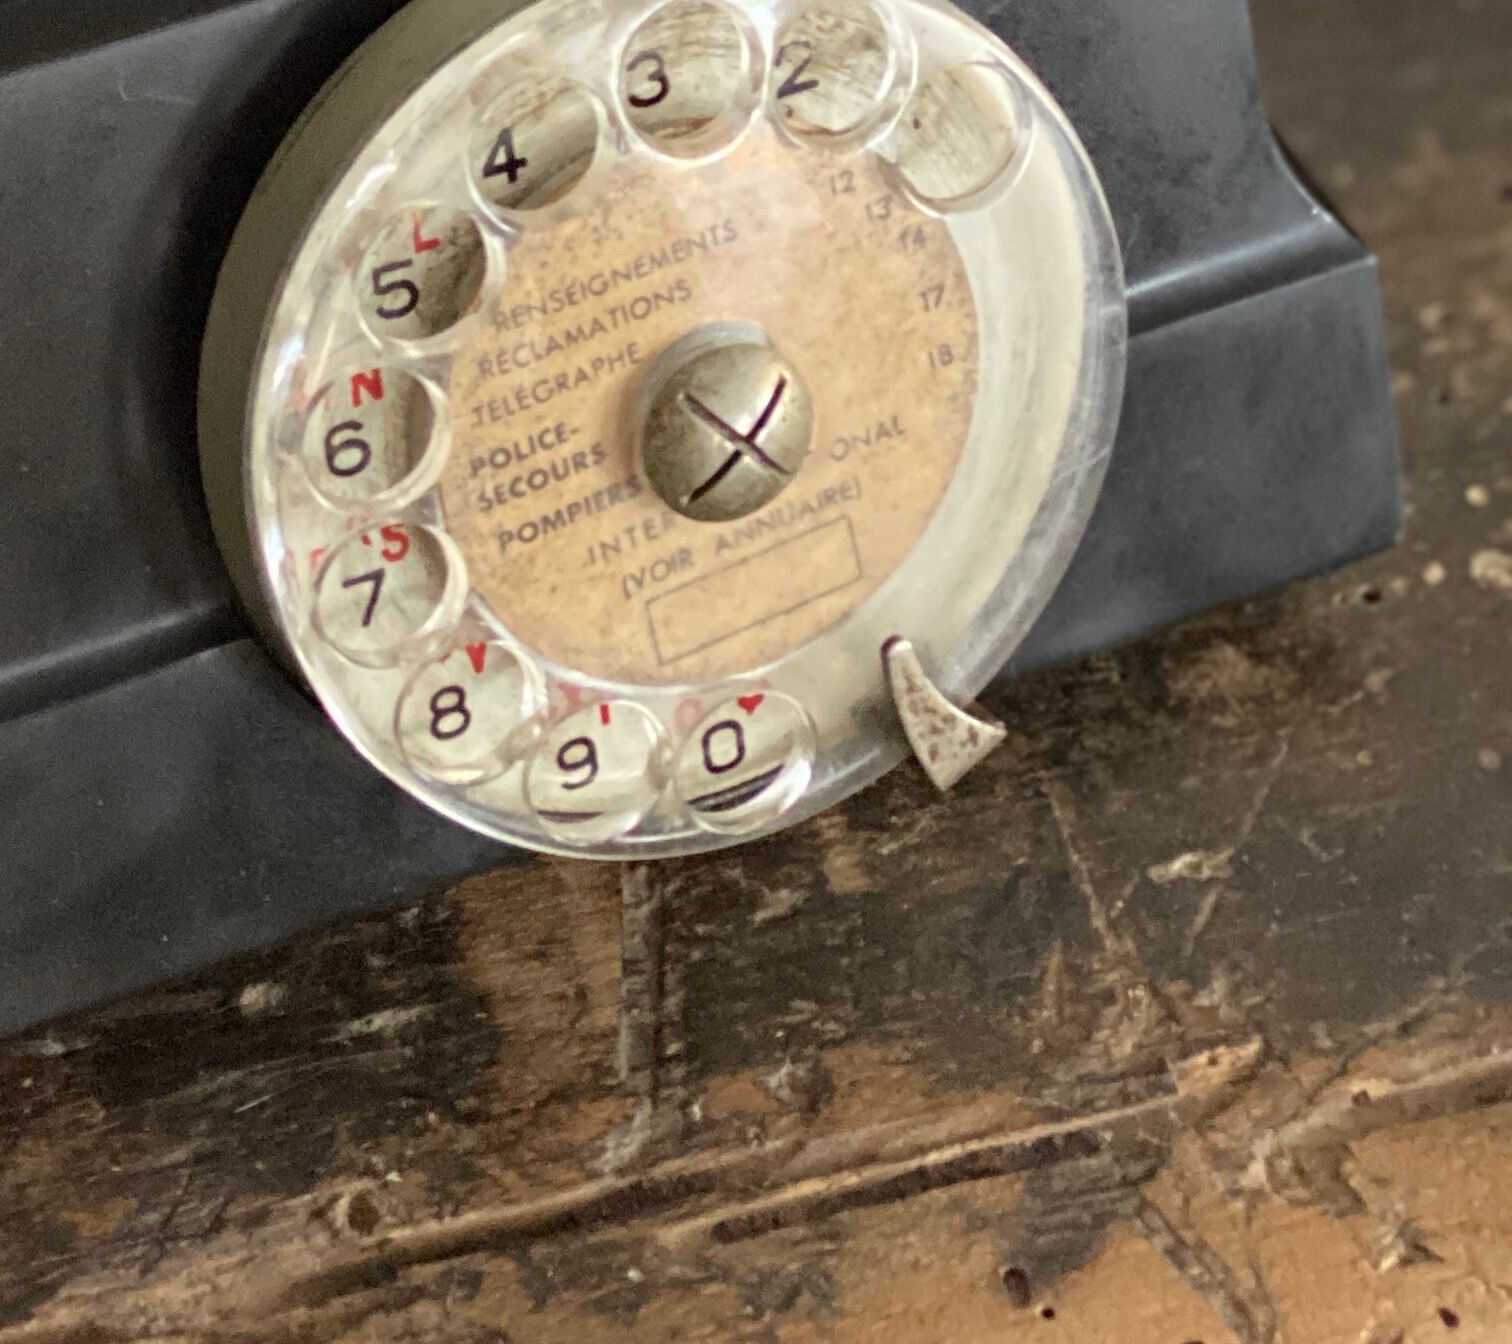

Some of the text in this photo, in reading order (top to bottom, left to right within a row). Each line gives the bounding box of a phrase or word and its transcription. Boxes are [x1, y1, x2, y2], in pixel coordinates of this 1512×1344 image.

[626, 50, 671, 108] 3
[774, 40, 819, 99] 2
[482, 126, 527, 184] 4
[829, 169, 856, 196] 12
[372, 259, 420, 320] 5
[325, 419, 372, 478] 6
[469, 422, 579, 479] POLICE-
[477, 442, 608, 513] SECOURS
[498, 472, 643, 556] POMPIERS
[621, 476, 862, 601] (VOIR ANNUAIRE)
[342, 567, 386, 628] 7
[429, 684, 471, 741] 8
[556, 735, 598, 790] 9
[701, 718, 745, 774] 0
